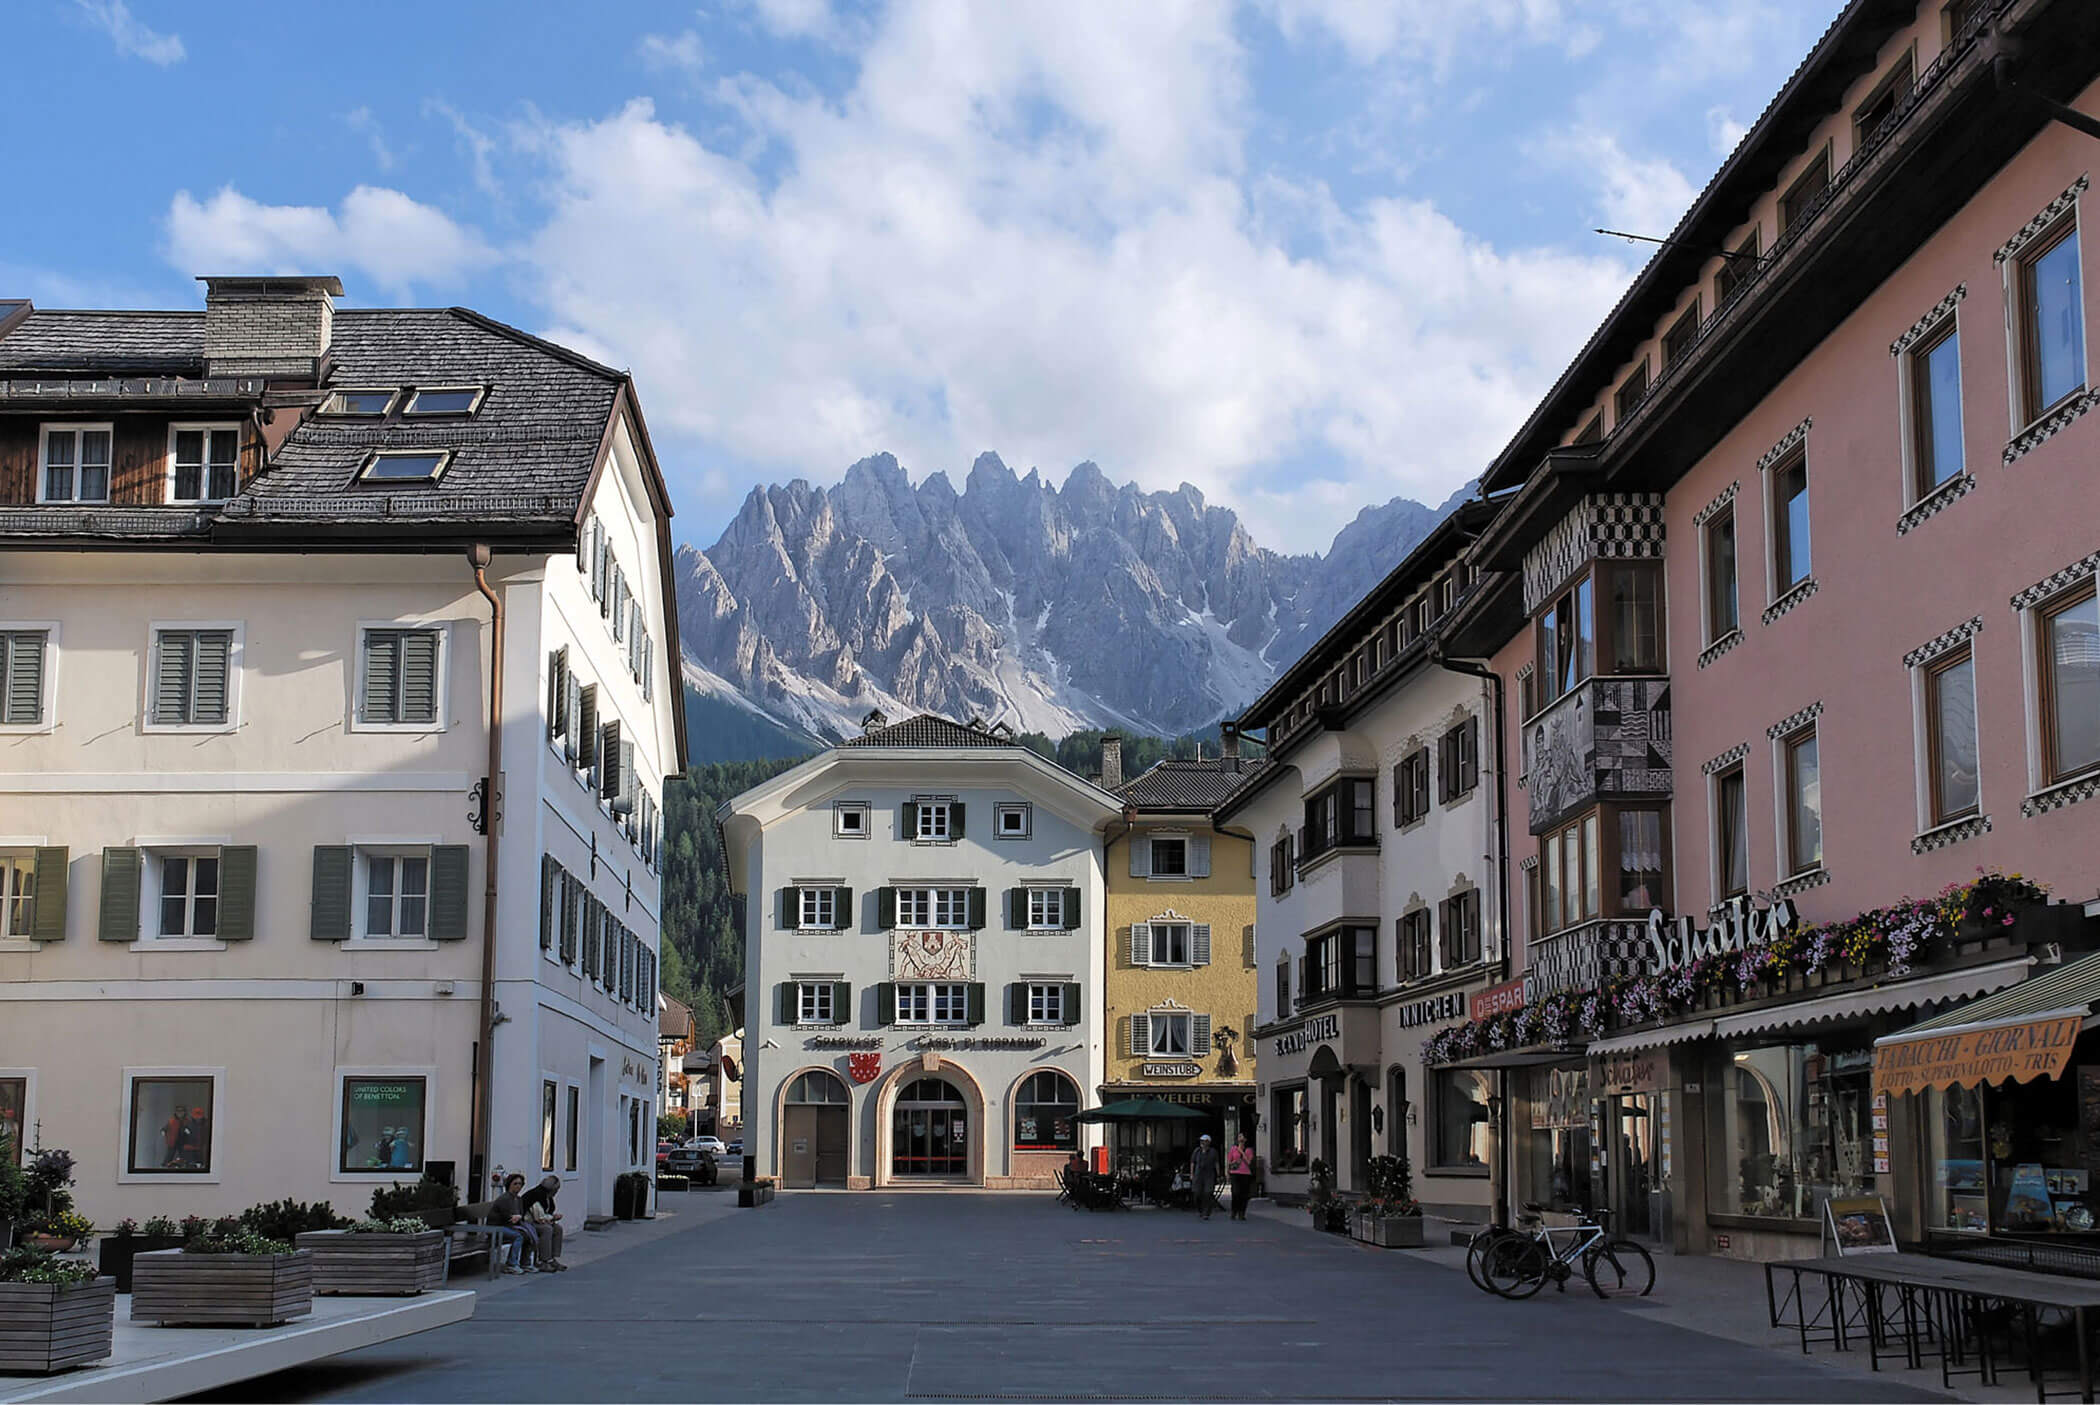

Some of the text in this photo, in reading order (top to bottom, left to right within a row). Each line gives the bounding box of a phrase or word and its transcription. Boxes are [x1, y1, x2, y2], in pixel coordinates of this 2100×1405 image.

[1304, 1015, 1338, 1041] HOTEL
[981, 1037, 1047, 1048] RISPARMIO
[1878, 1036, 1961, 1070] TABACCHI
[1974, 1019, 2078, 1057] GIORNALI
[1144, 1063, 1199, 1076] WEINSTUBE
[1880, 1071, 1914, 1088] LOTTO
[2024, 1052, 2060, 1071] TRIS
